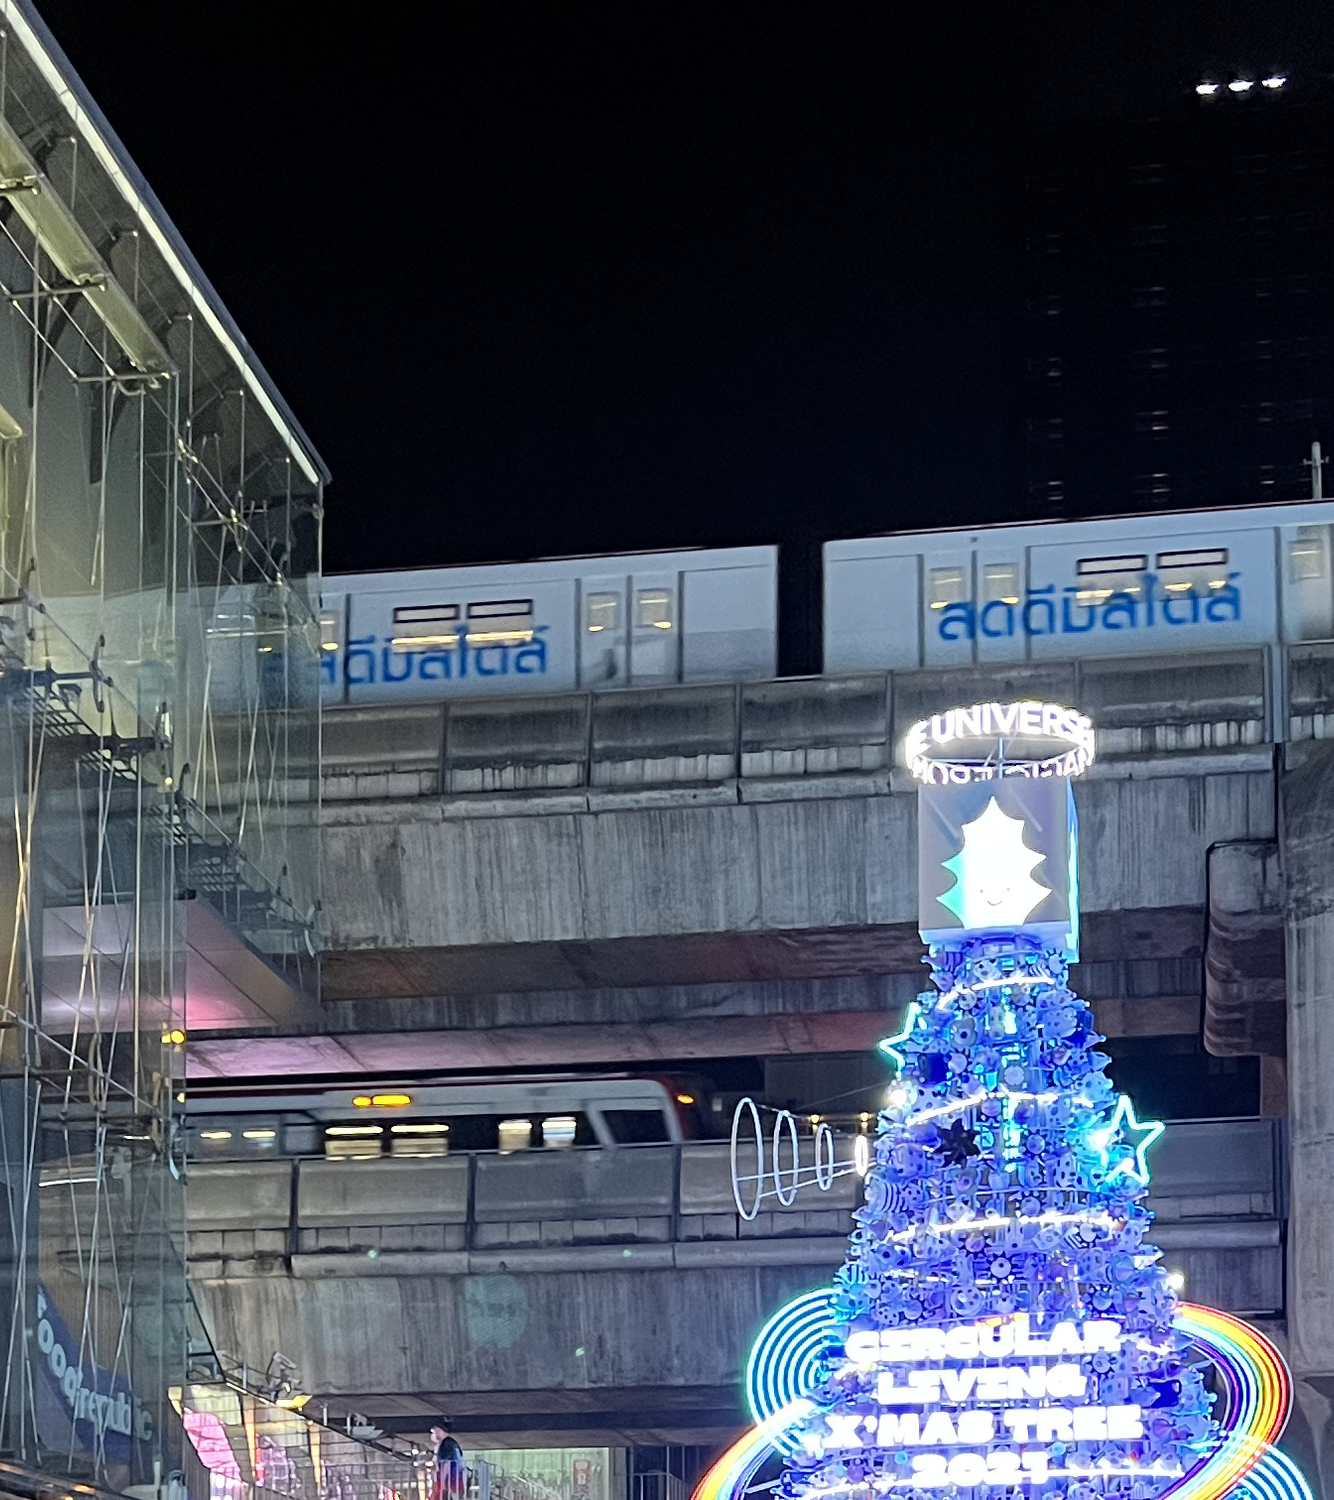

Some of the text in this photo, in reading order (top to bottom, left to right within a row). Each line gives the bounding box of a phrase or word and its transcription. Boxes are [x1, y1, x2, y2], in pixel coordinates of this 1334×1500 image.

[845, 1320, 1122, 1362] CIRCULAR
[876, 1364, 1087, 1404] LIVING
[824, 1405, 1143, 1449] X'MAS TREE
[912, 1451, 1050, 1486] 2021
